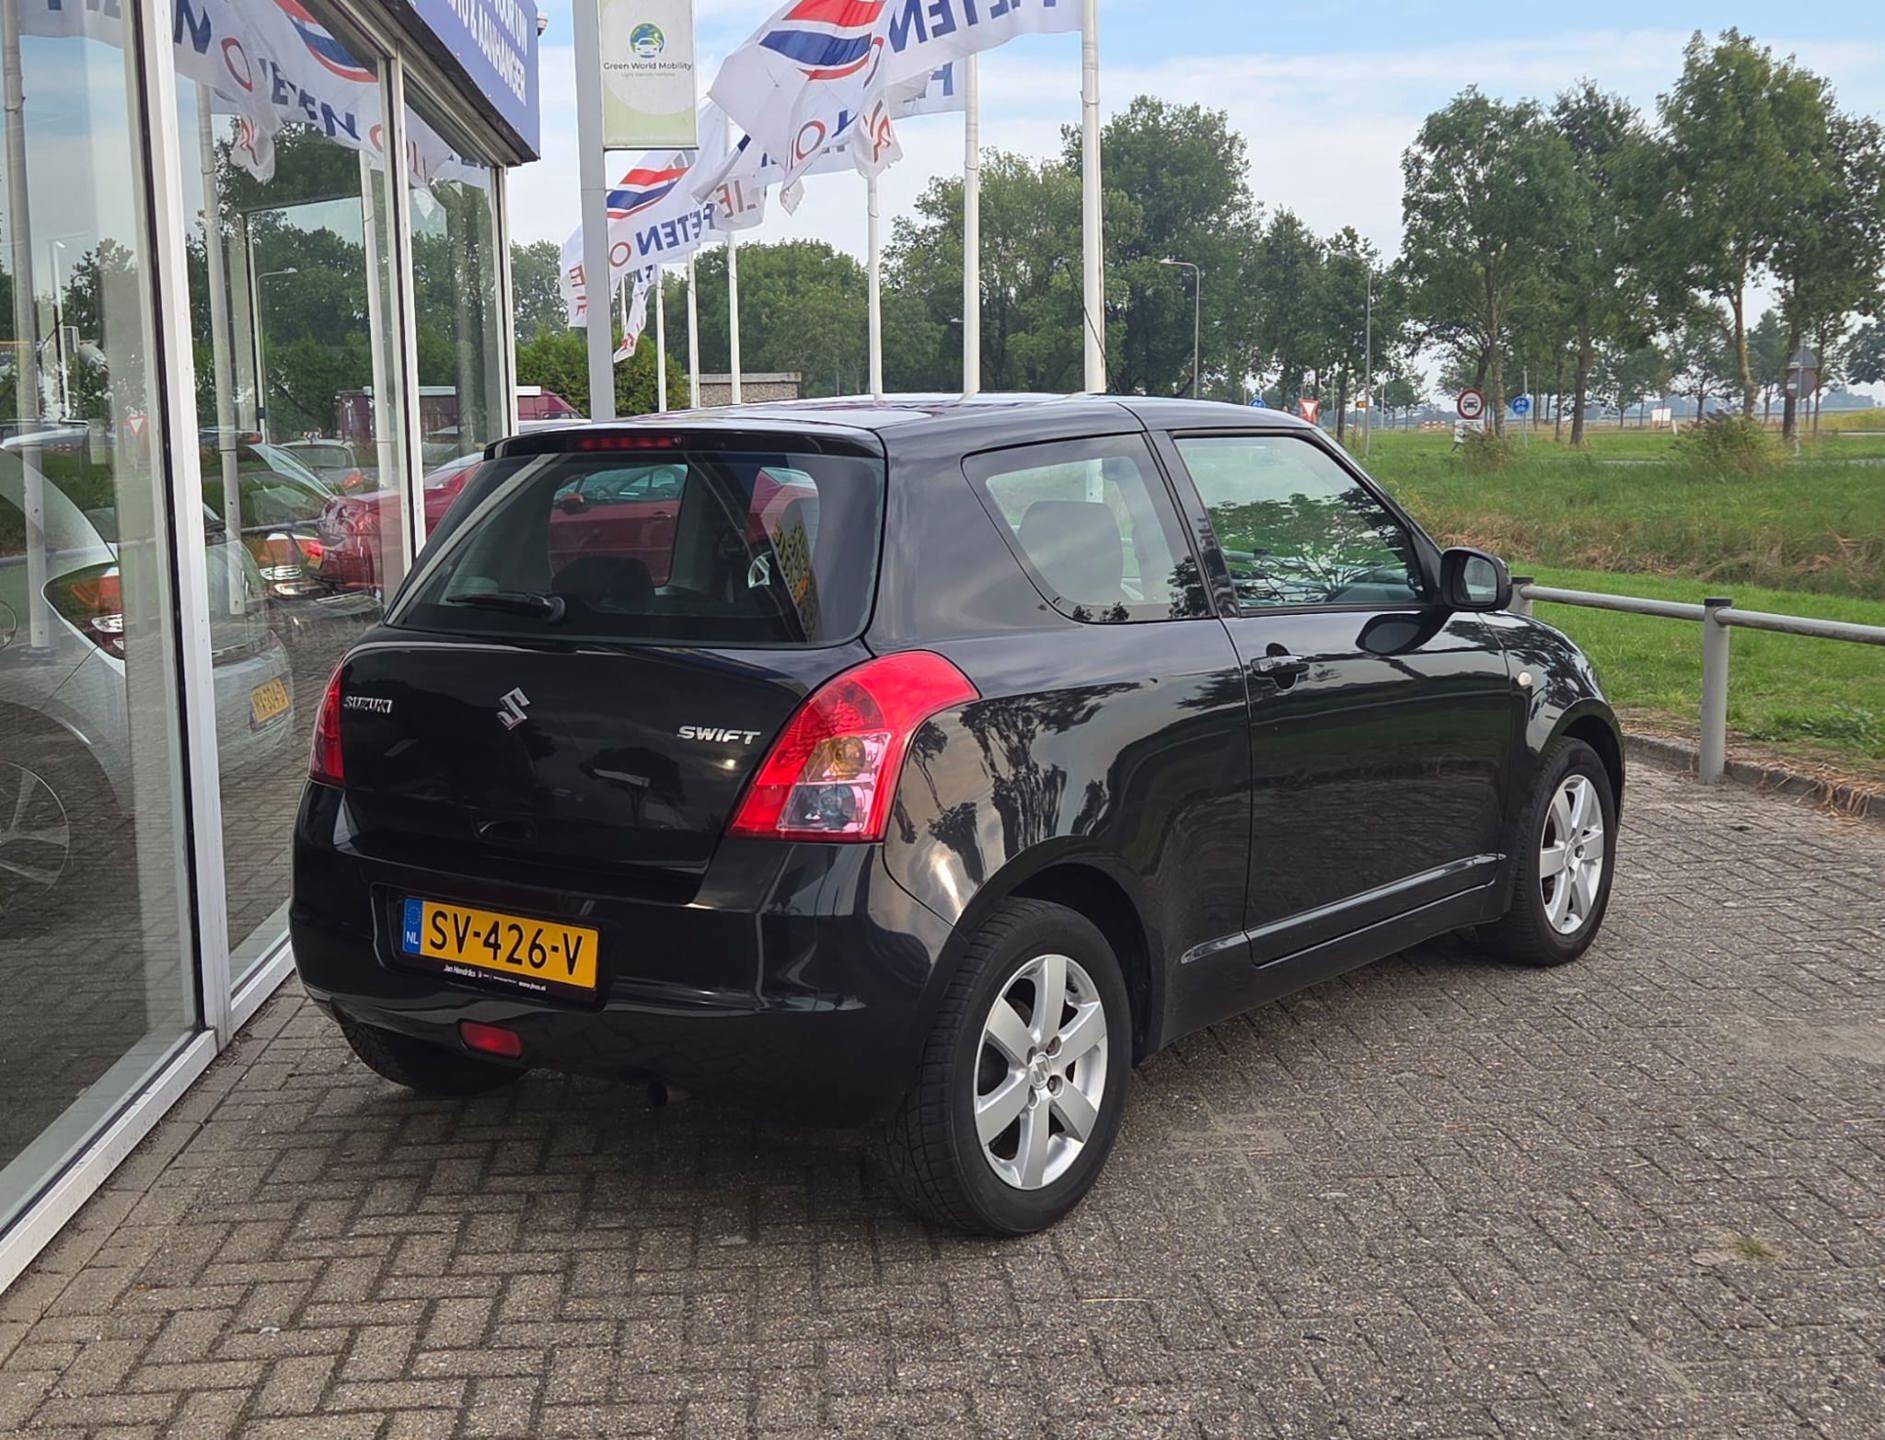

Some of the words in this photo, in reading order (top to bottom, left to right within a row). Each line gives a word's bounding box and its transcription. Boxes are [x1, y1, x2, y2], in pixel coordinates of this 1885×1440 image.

[603, 62, 629, 70] Green
[631, 62, 657, 70] World
[658, 62, 692, 71] Mobility
[343, 696, 393, 714] SUZUKI
[677, 725, 761, 745] SWIFT
[406, 931, 419, 945] NL
[429, 910, 583, 976] SV-426-V
